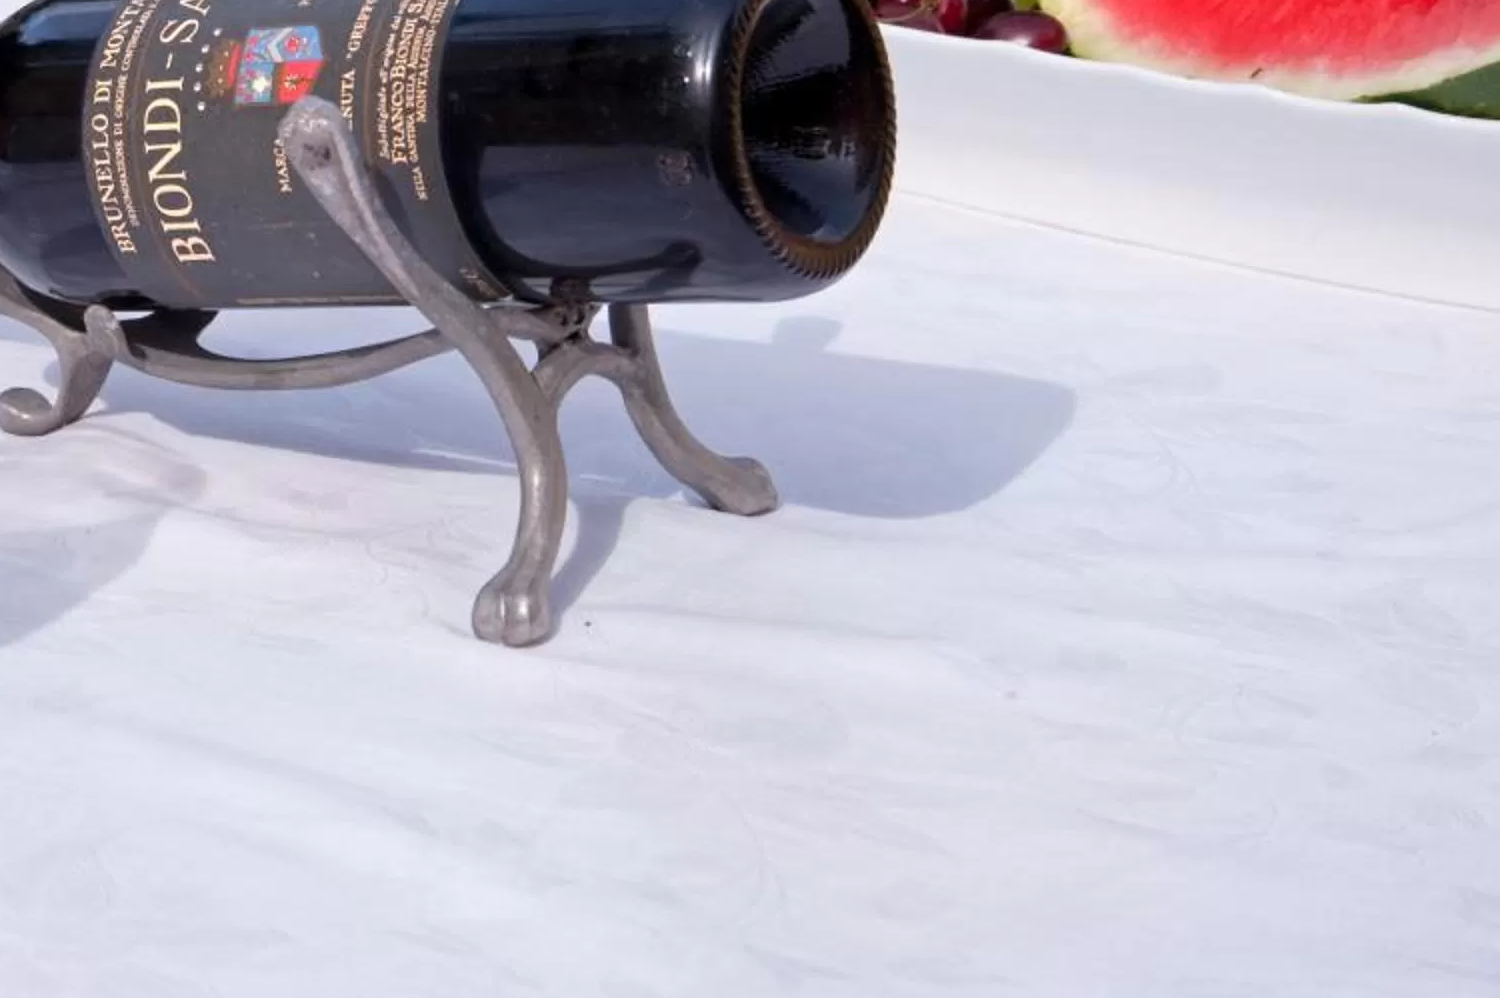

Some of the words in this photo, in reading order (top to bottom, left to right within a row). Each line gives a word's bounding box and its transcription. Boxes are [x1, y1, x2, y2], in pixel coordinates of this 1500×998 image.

[389, 17, 418, 80] BIONDI
[93, 78, 113, 105] DI
[391, 81, 408, 164] FRANCO
[113, 122, 124, 135] DI
[91, 113, 138, 254] BRUNELLO
